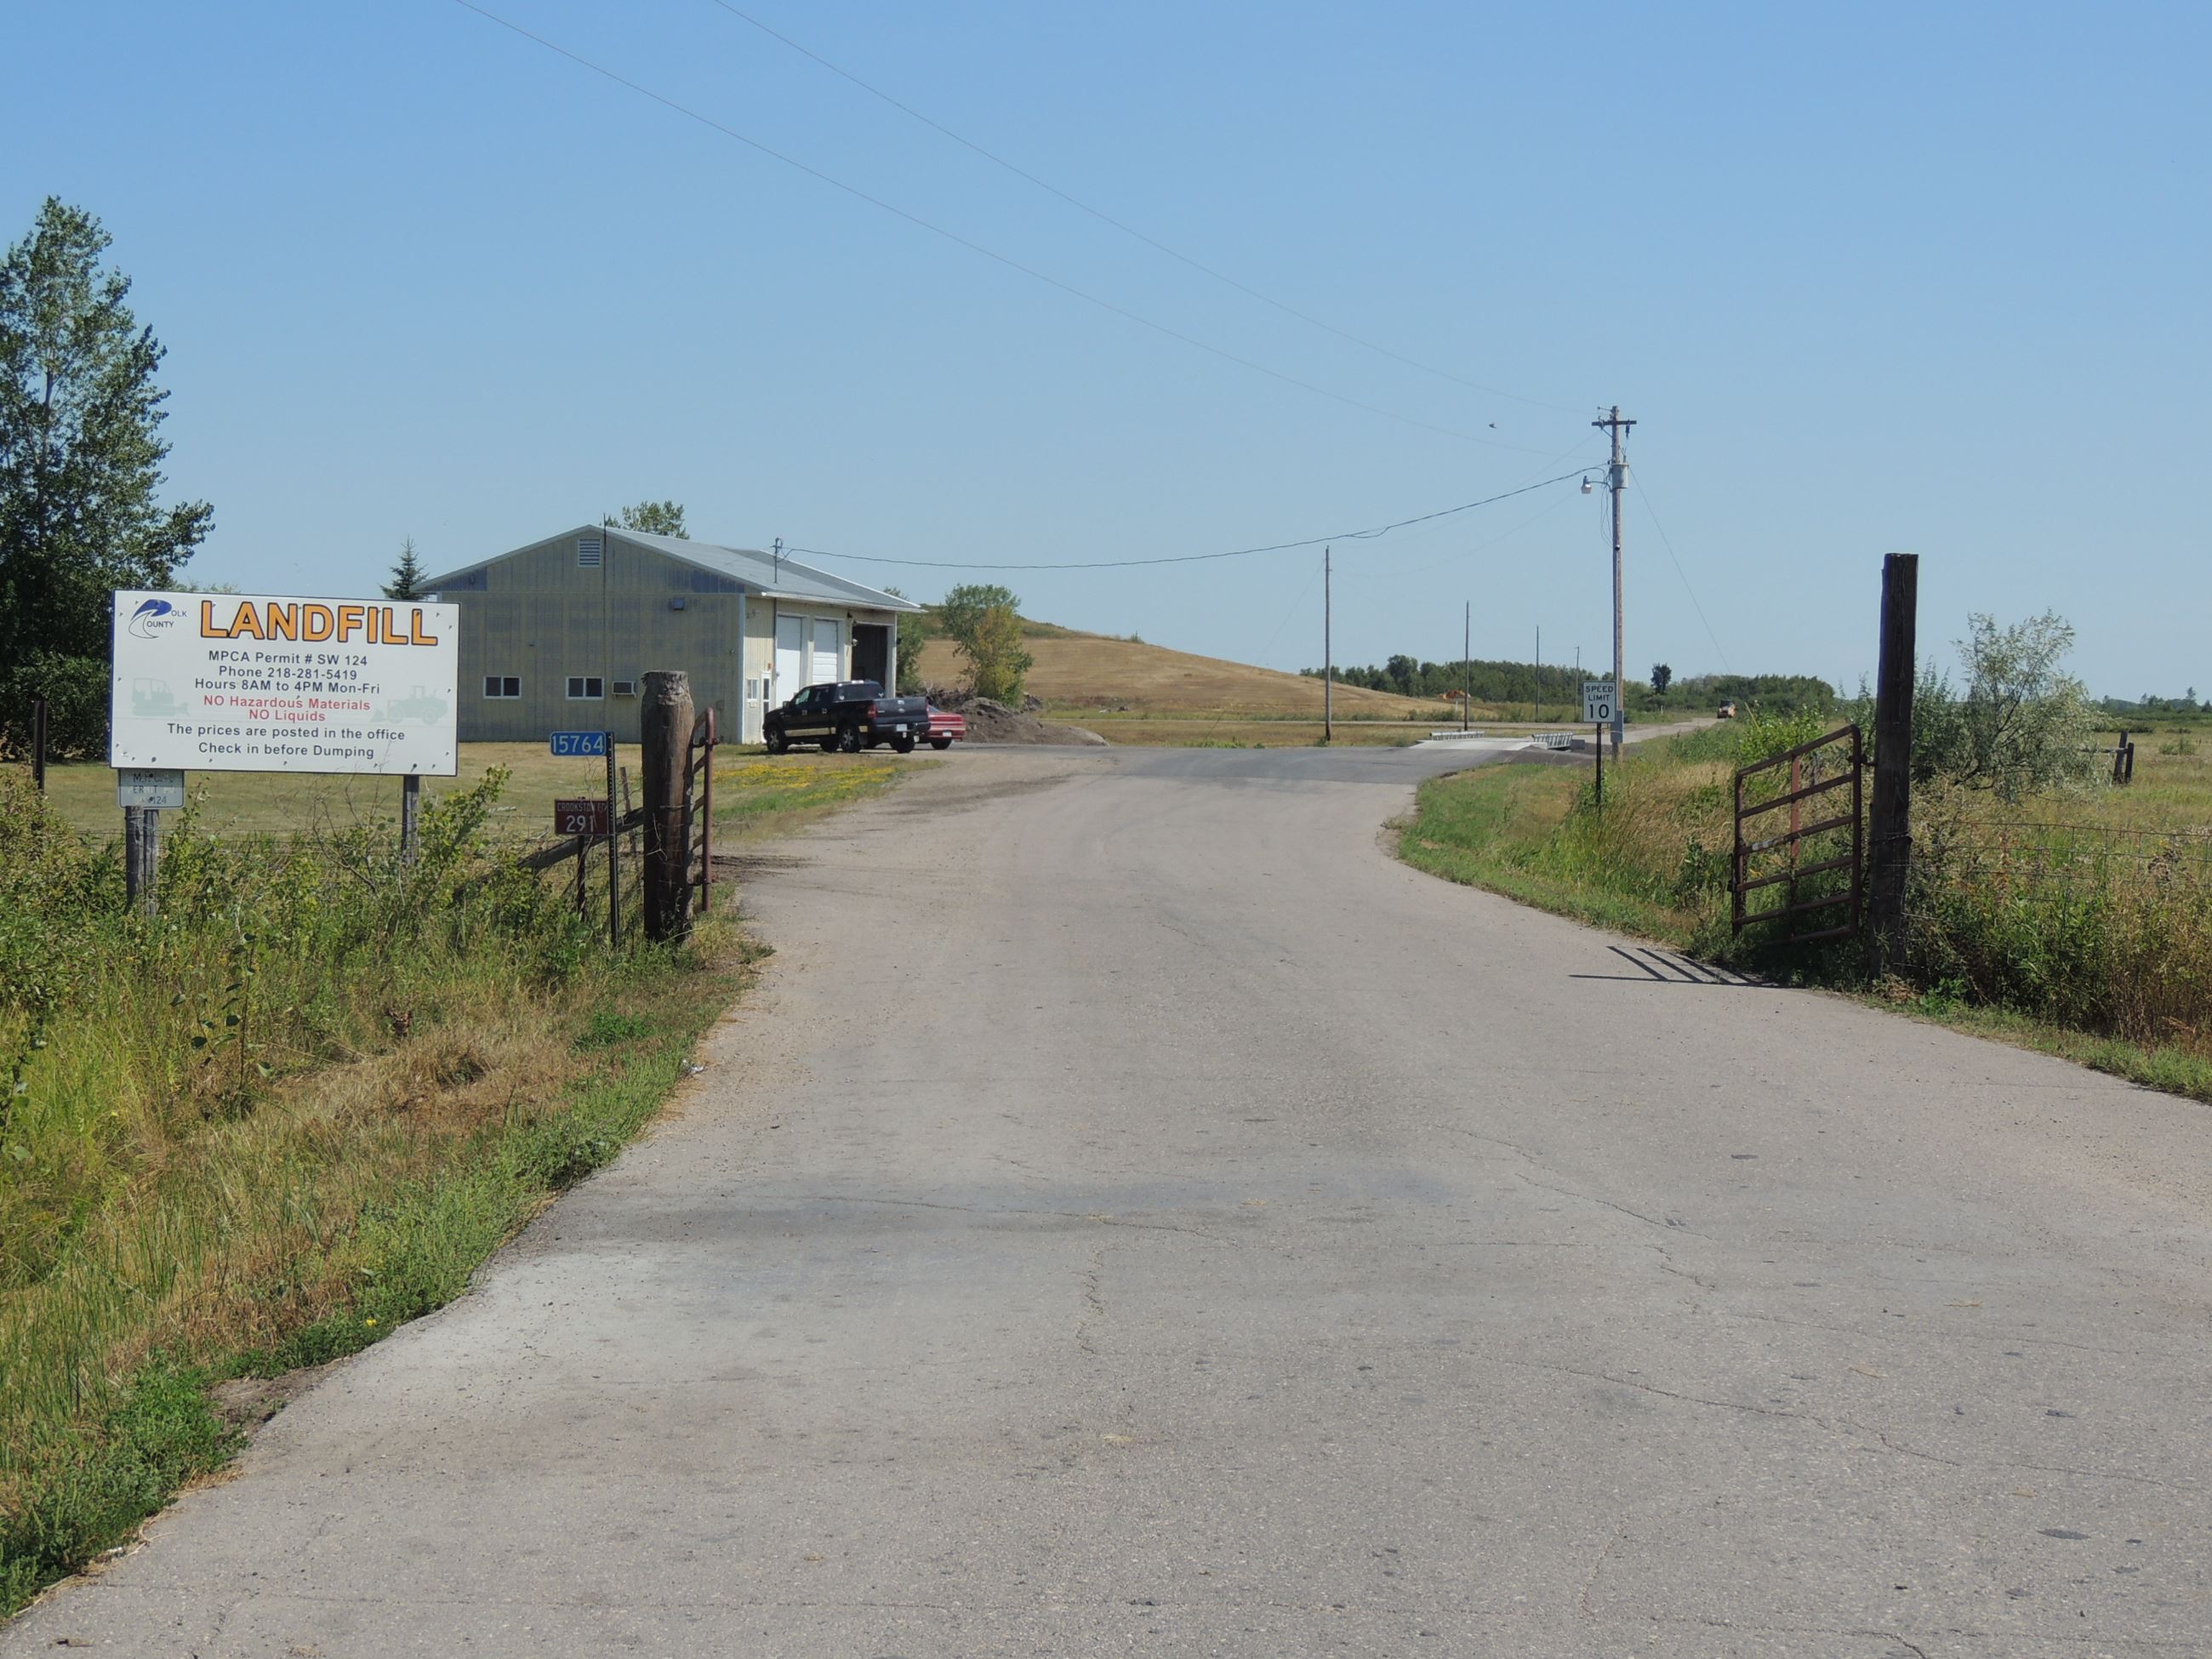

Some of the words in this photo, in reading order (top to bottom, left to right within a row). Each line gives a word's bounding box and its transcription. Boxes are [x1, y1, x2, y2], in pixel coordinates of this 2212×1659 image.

[201, 600, 438, 646] LANDFILL
[208, 650, 250, 663] MPCA
[255, 652, 300, 664] Permit
[305, 653, 312, 664] #
[317, 654, 339, 664] SW
[345, 655, 368, 666] 124
[219, 665, 262, 677] Phone
[267, 667, 357, 681] 218-281-5419
[195, 678, 236, 691] Hours
[241, 680, 271, 692] 8AM
[276, 681, 289, 692] to
[294, 681, 323, 693] 4PM
[328, 682, 380, 694] Mon-Fri
[203, 695, 225, 706] NO
[230, 696, 303, 709] Hazardous
[308, 698, 371, 711] Materials
[249, 710, 270, 721] NO
[275, 710, 326, 723] Liquids
[1589, 704, 1609, 719] 10
[168, 723, 192, 735] The
[197, 724, 241, 738] prices
[246, 727, 267, 737] are
[272, 727, 319, 739] posted
[324, 727, 336, 738] in
[341, 728, 362, 739] the
[368, 729, 405, 740] office
[198, 742, 242, 754] Check
[247, 743, 259, 754] in
[264, 744, 308, 755] before
[313, 745, 374, 759] Dumping
[552, 735, 604, 753] 15764
[566, 815, 594, 833] 291
